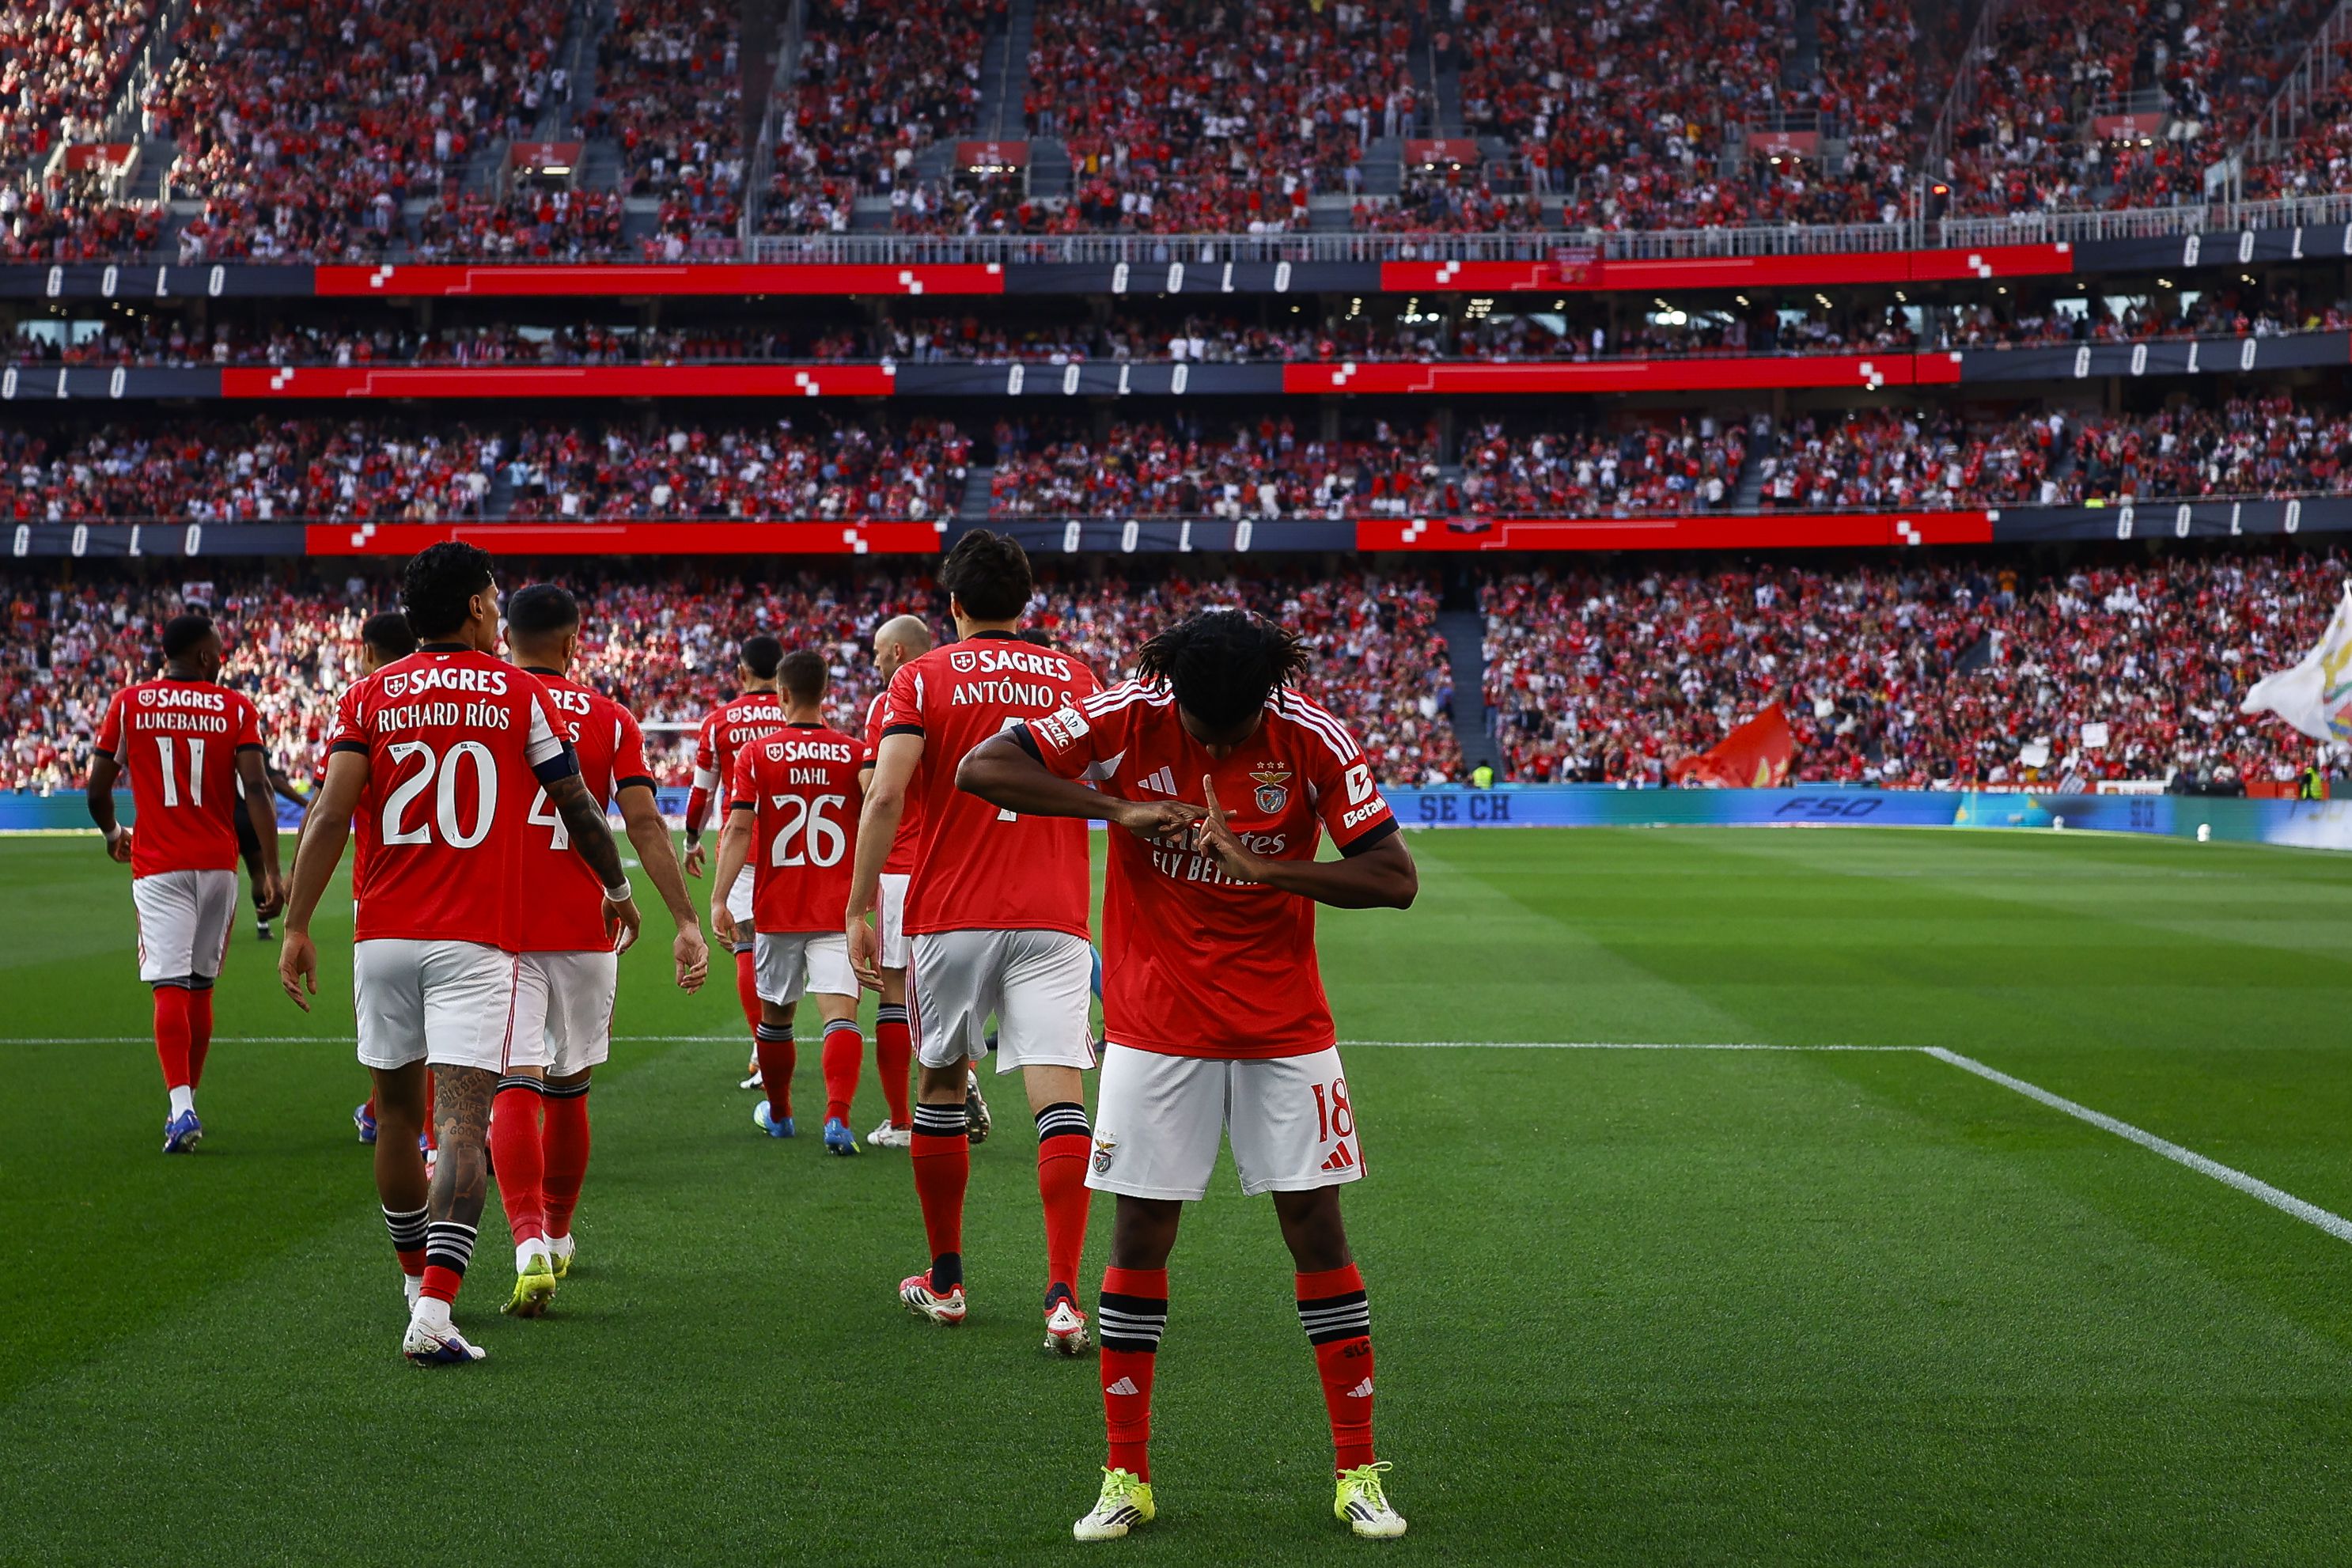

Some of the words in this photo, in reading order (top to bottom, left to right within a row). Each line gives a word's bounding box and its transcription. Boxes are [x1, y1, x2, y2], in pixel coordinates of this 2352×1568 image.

[46, 265, 225, 297] GOLO
[1112, 261, 1293, 294] GOLO
[2074, 338, 2257, 378] GOLO
[1007, 363, 1189, 396] GOLO
[2116, 498, 2301, 540] GOLO
[13, 524, 203, 557] GOLO
[1062, 520, 1253, 553] GOLO
[408, 668, 508, 696] SAGRES
[979, 650, 1073, 682] SAGRES
[157, 687, 225, 711] SAGRES
[547, 688, 591, 715] RES
[951, 676, 1054, 708] ANTÓNIO
[136, 712, 227, 733] LUKEBAKIO
[378, 702, 460, 733] RICHARD
[465, 698, 511, 730] RÍOS
[742, 705, 787, 723] SAGR
[1043, 714, 1070, 748] etclic
[785, 740, 852, 763] SAGRES
[155, 737, 205, 808] 11
[790, 767, 831, 786] DAHL
[382, 740, 498, 849] 20
[1420, 793, 1457, 821] SE
[1470, 793, 1513, 820] CH
[1342, 797, 1387, 829] Betan
[771, 793, 846, 868] 26
[1153, 850, 1184, 878] FLY
[459, 1101, 482, 1113] LIFE
[461, 1113, 472, 1124] IS
[1310, 1077, 1354, 1143] 18
